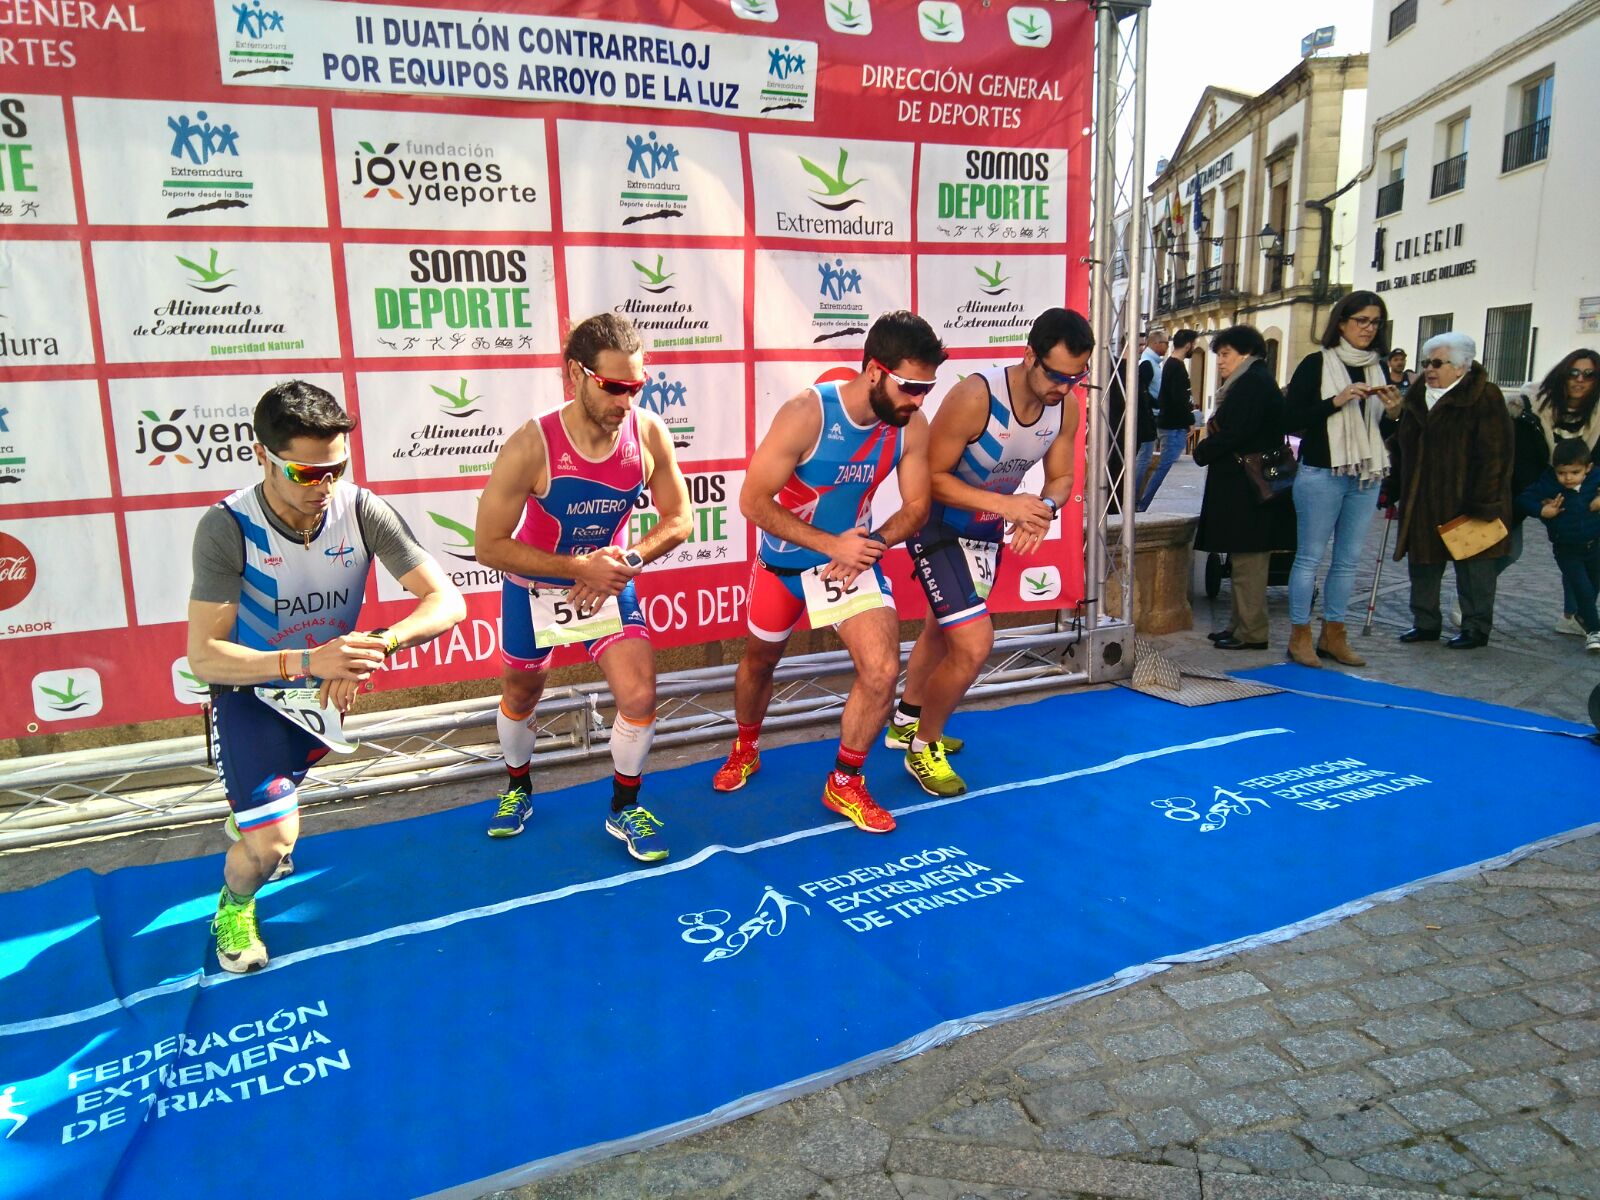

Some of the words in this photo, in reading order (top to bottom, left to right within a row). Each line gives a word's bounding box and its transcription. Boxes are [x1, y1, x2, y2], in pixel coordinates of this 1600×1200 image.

[235, 40, 287, 50] Extremadura
[355, 15, 374, 44] II
[383, 17, 509, 51] DUATLÓN
[518, 25, 711, 71] CONTRARRELOJ
[322, 52, 381, 83] POR
[389, 57, 509, 90] EQUIPOS
[517, 64, 617, 98] ARROYO
[625, 72, 656, 100] DE
[663, 76, 693, 103] LA
[697, 80, 740, 109] LUZ
[861, 64, 973, 95] DIRECCIÓN
[978, 74, 1064, 102] GENERAL
[898, 100, 922, 122] DE
[928, 101, 1022, 129] DEPORTES
[406, 140, 494, 158] fundación
[171, 167, 243, 178] Extremadura
[965, 150, 1049, 181] SOMOS
[161, 189, 195, 198] Deporte
[197, 190, 222, 198] desde
[224, 190, 232, 198] la
[234, 191, 253, 199] Base
[408, 182, 537, 207] ydeporte
[627, 180, 681, 191] Extremadura
[619, 200, 643, 208] Deporte
[938, 183, 1049, 221] DEPORTE
[776, 212, 894, 236] Extremadura
[1395, 223, 1464, 261] COLEGIO
[409, 249, 527, 284] SOMOS
[1410, 272, 1420, 285] DE
[1421, 268, 1437, 283] LOS
[1438, 259, 1477, 280] DOLORES
[154, 299, 263, 316] Alimentos
[374, 287, 532, 330] DEPORTE
[614, 298, 694, 313] Alimentos
[819, 302, 863, 310] Extremadura
[957, 300, 1025, 313] Alimentos
[133, 325, 149, 336] de
[150, 319, 287, 337] Extremadura
[943, 320, 953, 328] de
[210, 341, 266, 356] Diversidad
[267, 339, 305, 351] Natural
[653, 336, 693, 348] Diversidad
[694, 334, 723, 345] Natural
[988, 333, 1024, 344] Diversidad
[410, 424, 505, 439] Alimentos
[393, 448, 406, 458] de
[5, 466, 26, 474] Base
[834, 464, 875, 484] ZAPATA
[992, 458, 1035, 474] CASTRO
[566, 498, 627, 515] MONTERO
[914, 543, 944, 603] CAPEX
[975, 555, 993, 582] 5A
[274, 588, 349, 617] PADIN
[8, 621, 53, 635] SABOR
[267, 617, 325, 645] PLANCHAS
[1237, 757, 1368, 790] FEDERACIÓN
[1272, 767, 1396, 800] EXTREMEÑA
[1296, 797, 1342, 811] DE
[1337, 774, 1433, 803] TRIATLON
[798, 845, 970, 898] FEDERACIÓN
[826, 859, 992, 913] EXTREMEÑA
[842, 909, 894, 933] DE
[894, 871, 1025, 919] TRIATLON
[68, 1000, 329, 1090] FEDERACIÓN
[76, 1029, 331, 1114] EXTREMEÑA
[61, 1106, 126, 1145] DE
[139, 1048, 351, 1123] TRIATLON
